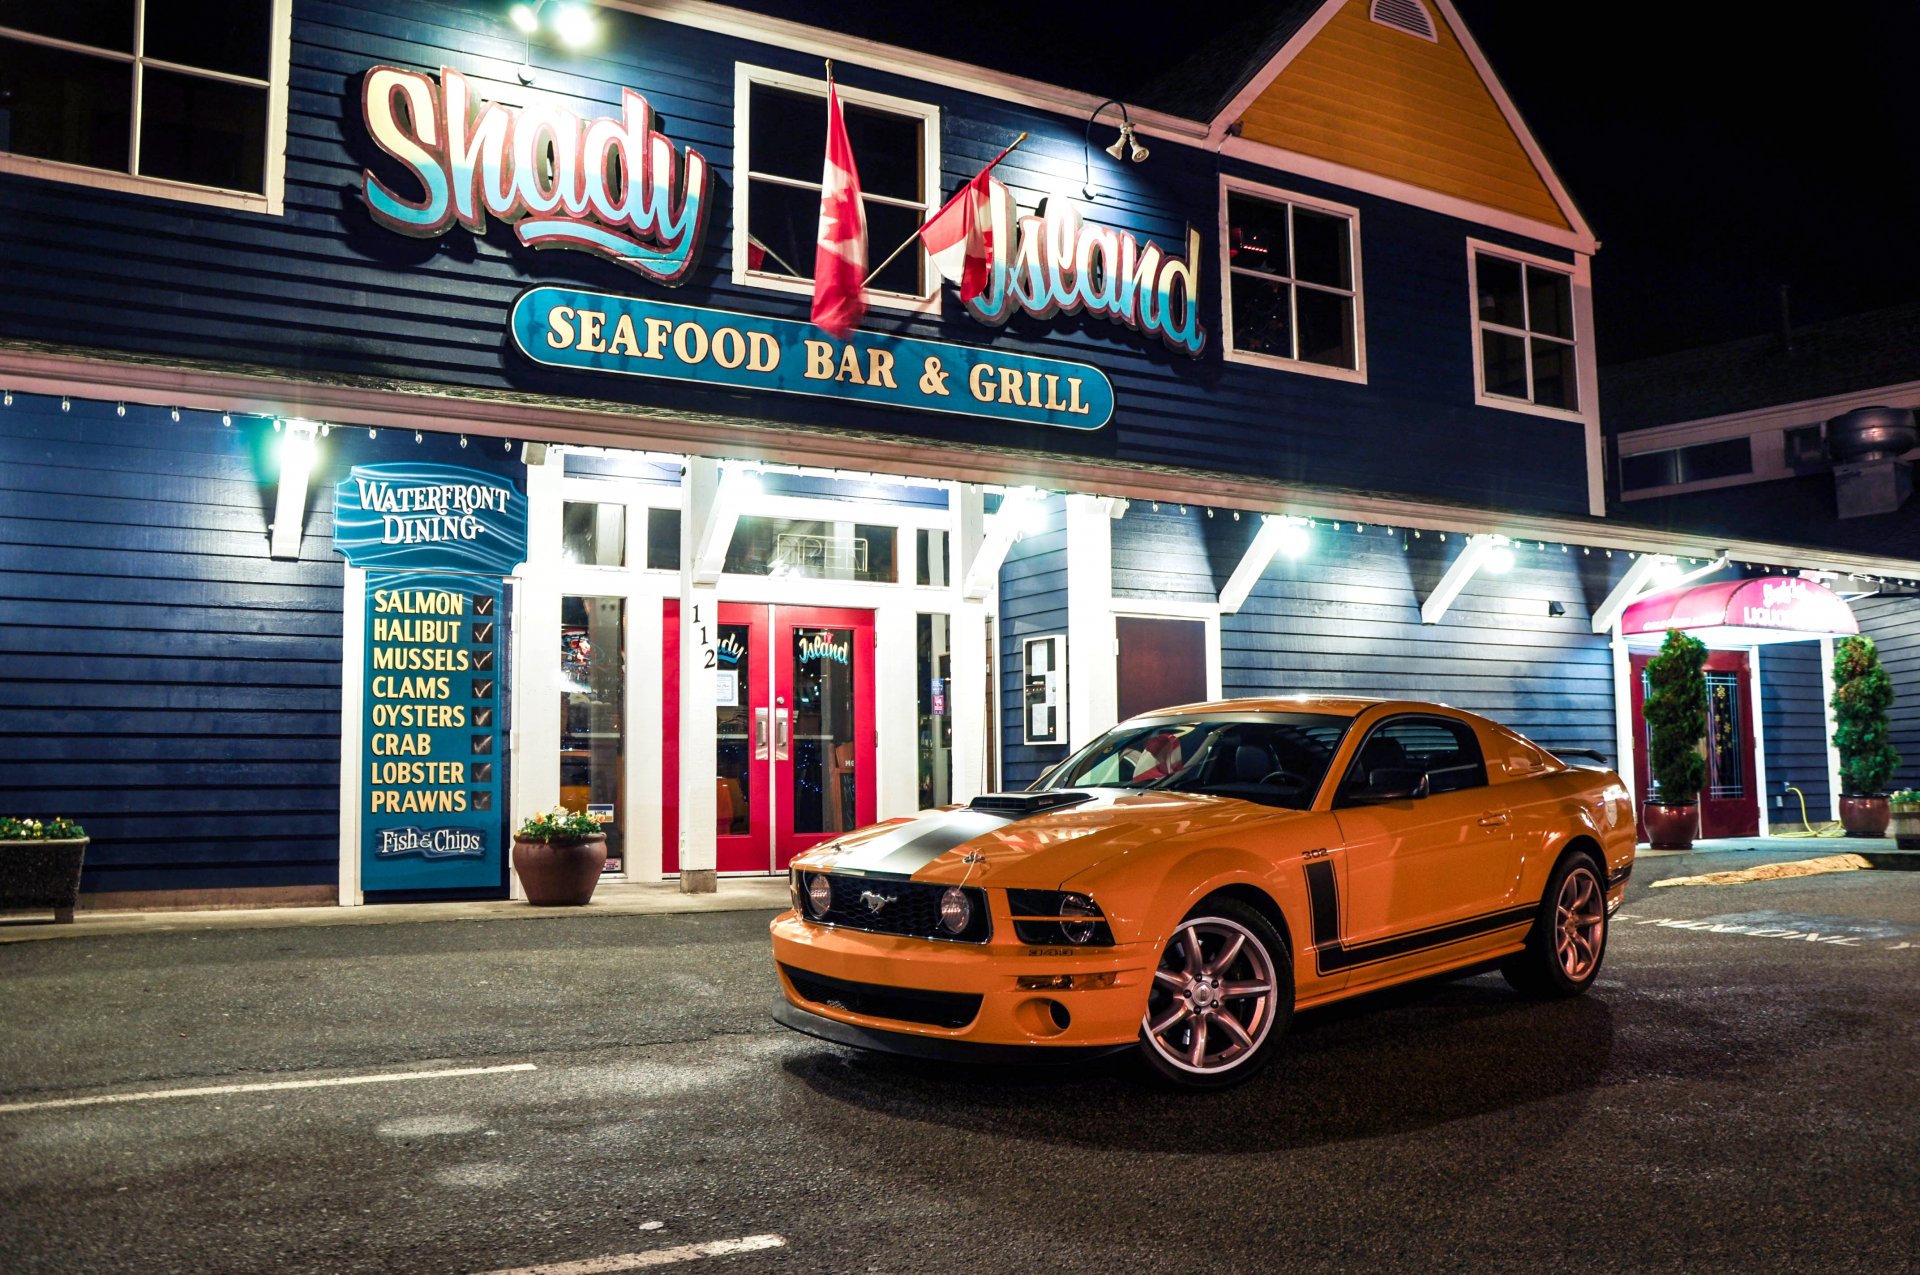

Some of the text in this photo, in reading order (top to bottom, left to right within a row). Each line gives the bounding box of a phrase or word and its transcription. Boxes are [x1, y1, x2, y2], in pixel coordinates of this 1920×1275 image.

[362, 64, 1207, 357] Shady Island
[547, 305, 1091, 415] SEAFOOD BAR & GRILL
[355, 477, 511, 516] WATERFRONT
[381, 514, 485, 544] DINING
[374, 589, 463, 616] SALMON
[373, 618, 461, 643] HALIBUT
[373, 647, 469, 672] MUSSELS
[798, 635, 849, 665] Island
[372, 676, 450, 699] CLAMS
[372, 704, 466, 728] OYSTERS
[371, 733, 432, 756] CRAB
[371, 762, 465, 784] LOBSTER
[371, 789, 467, 814] PRAWNS
[381, 828, 480, 855] Fish & Chips
[1301, 847, 1329, 860] 302
